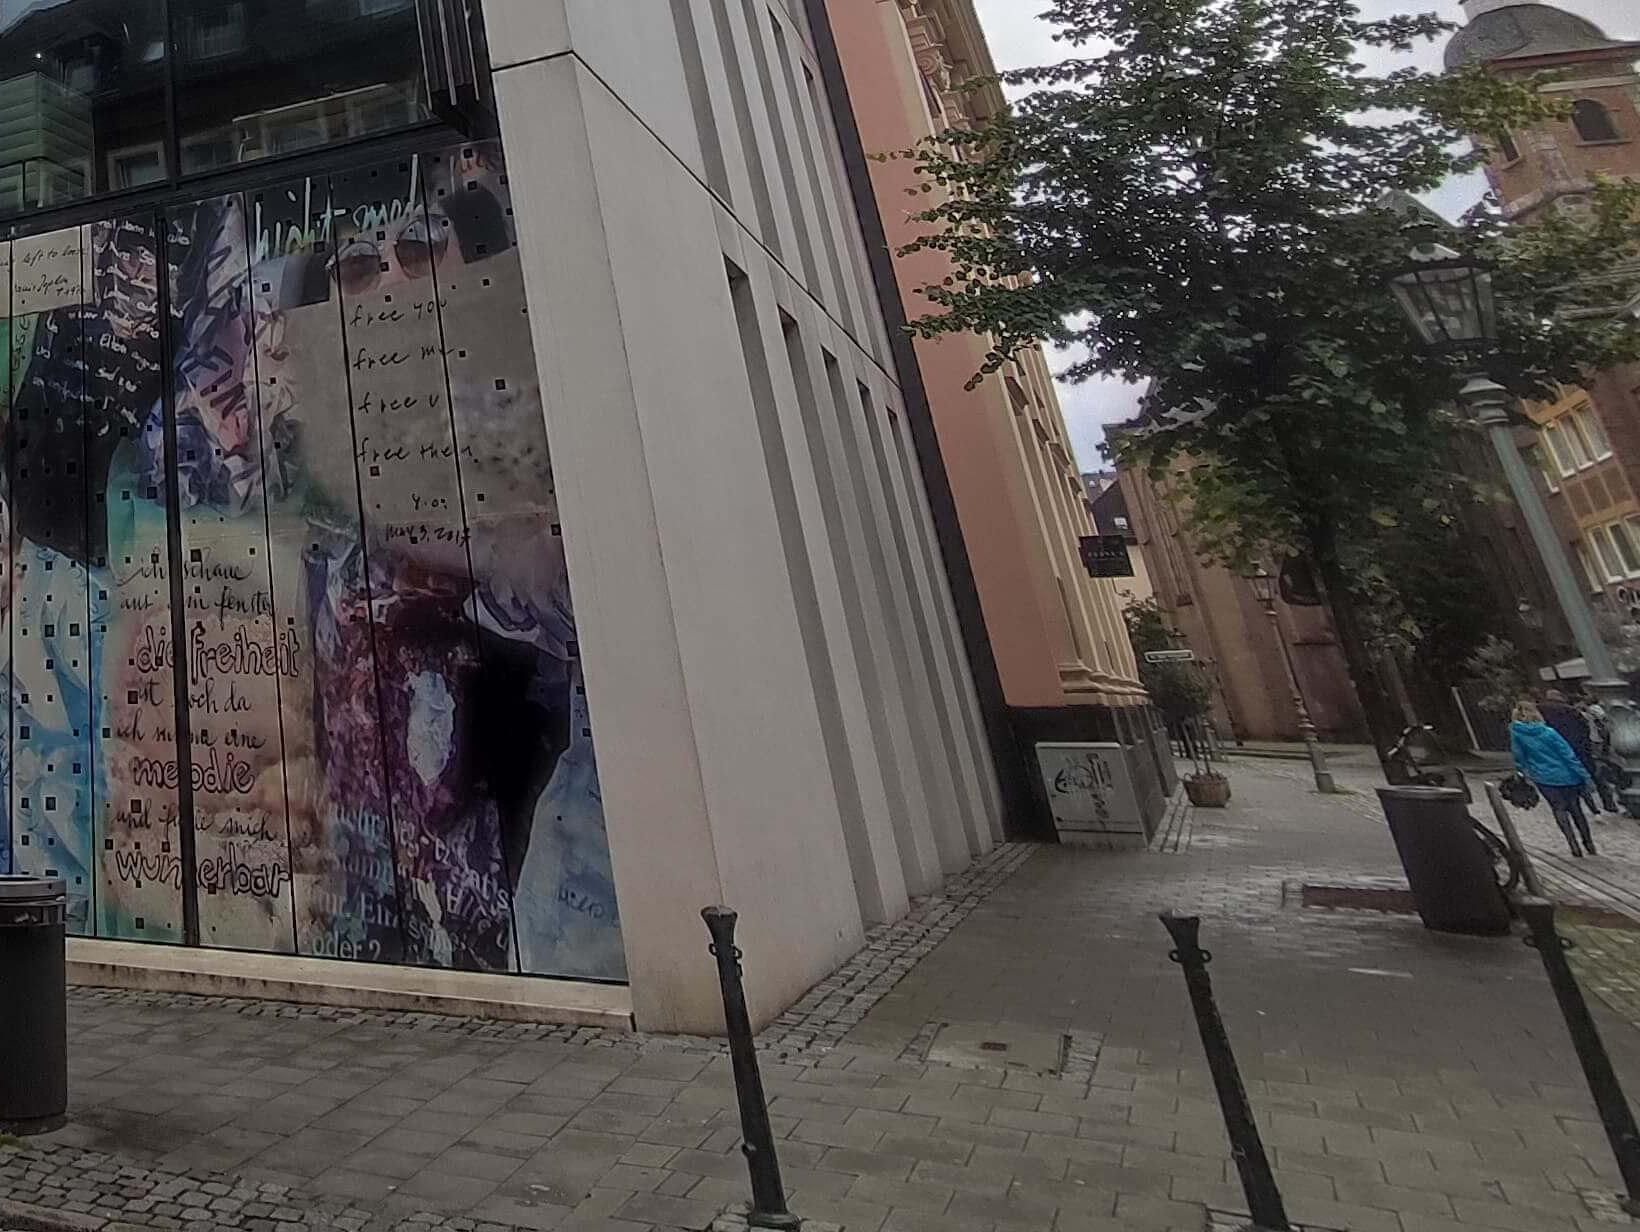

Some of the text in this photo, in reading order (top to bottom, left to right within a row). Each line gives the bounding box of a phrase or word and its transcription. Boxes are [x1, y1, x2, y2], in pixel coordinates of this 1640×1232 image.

[350, 303, 406, 328] free
[353, 347, 411, 370] free
[358, 391, 418, 415] free
[190, 620, 300, 686] freiheit
[132, 747, 256, 795] meodie
[115, 841, 292, 900] wunerbar
